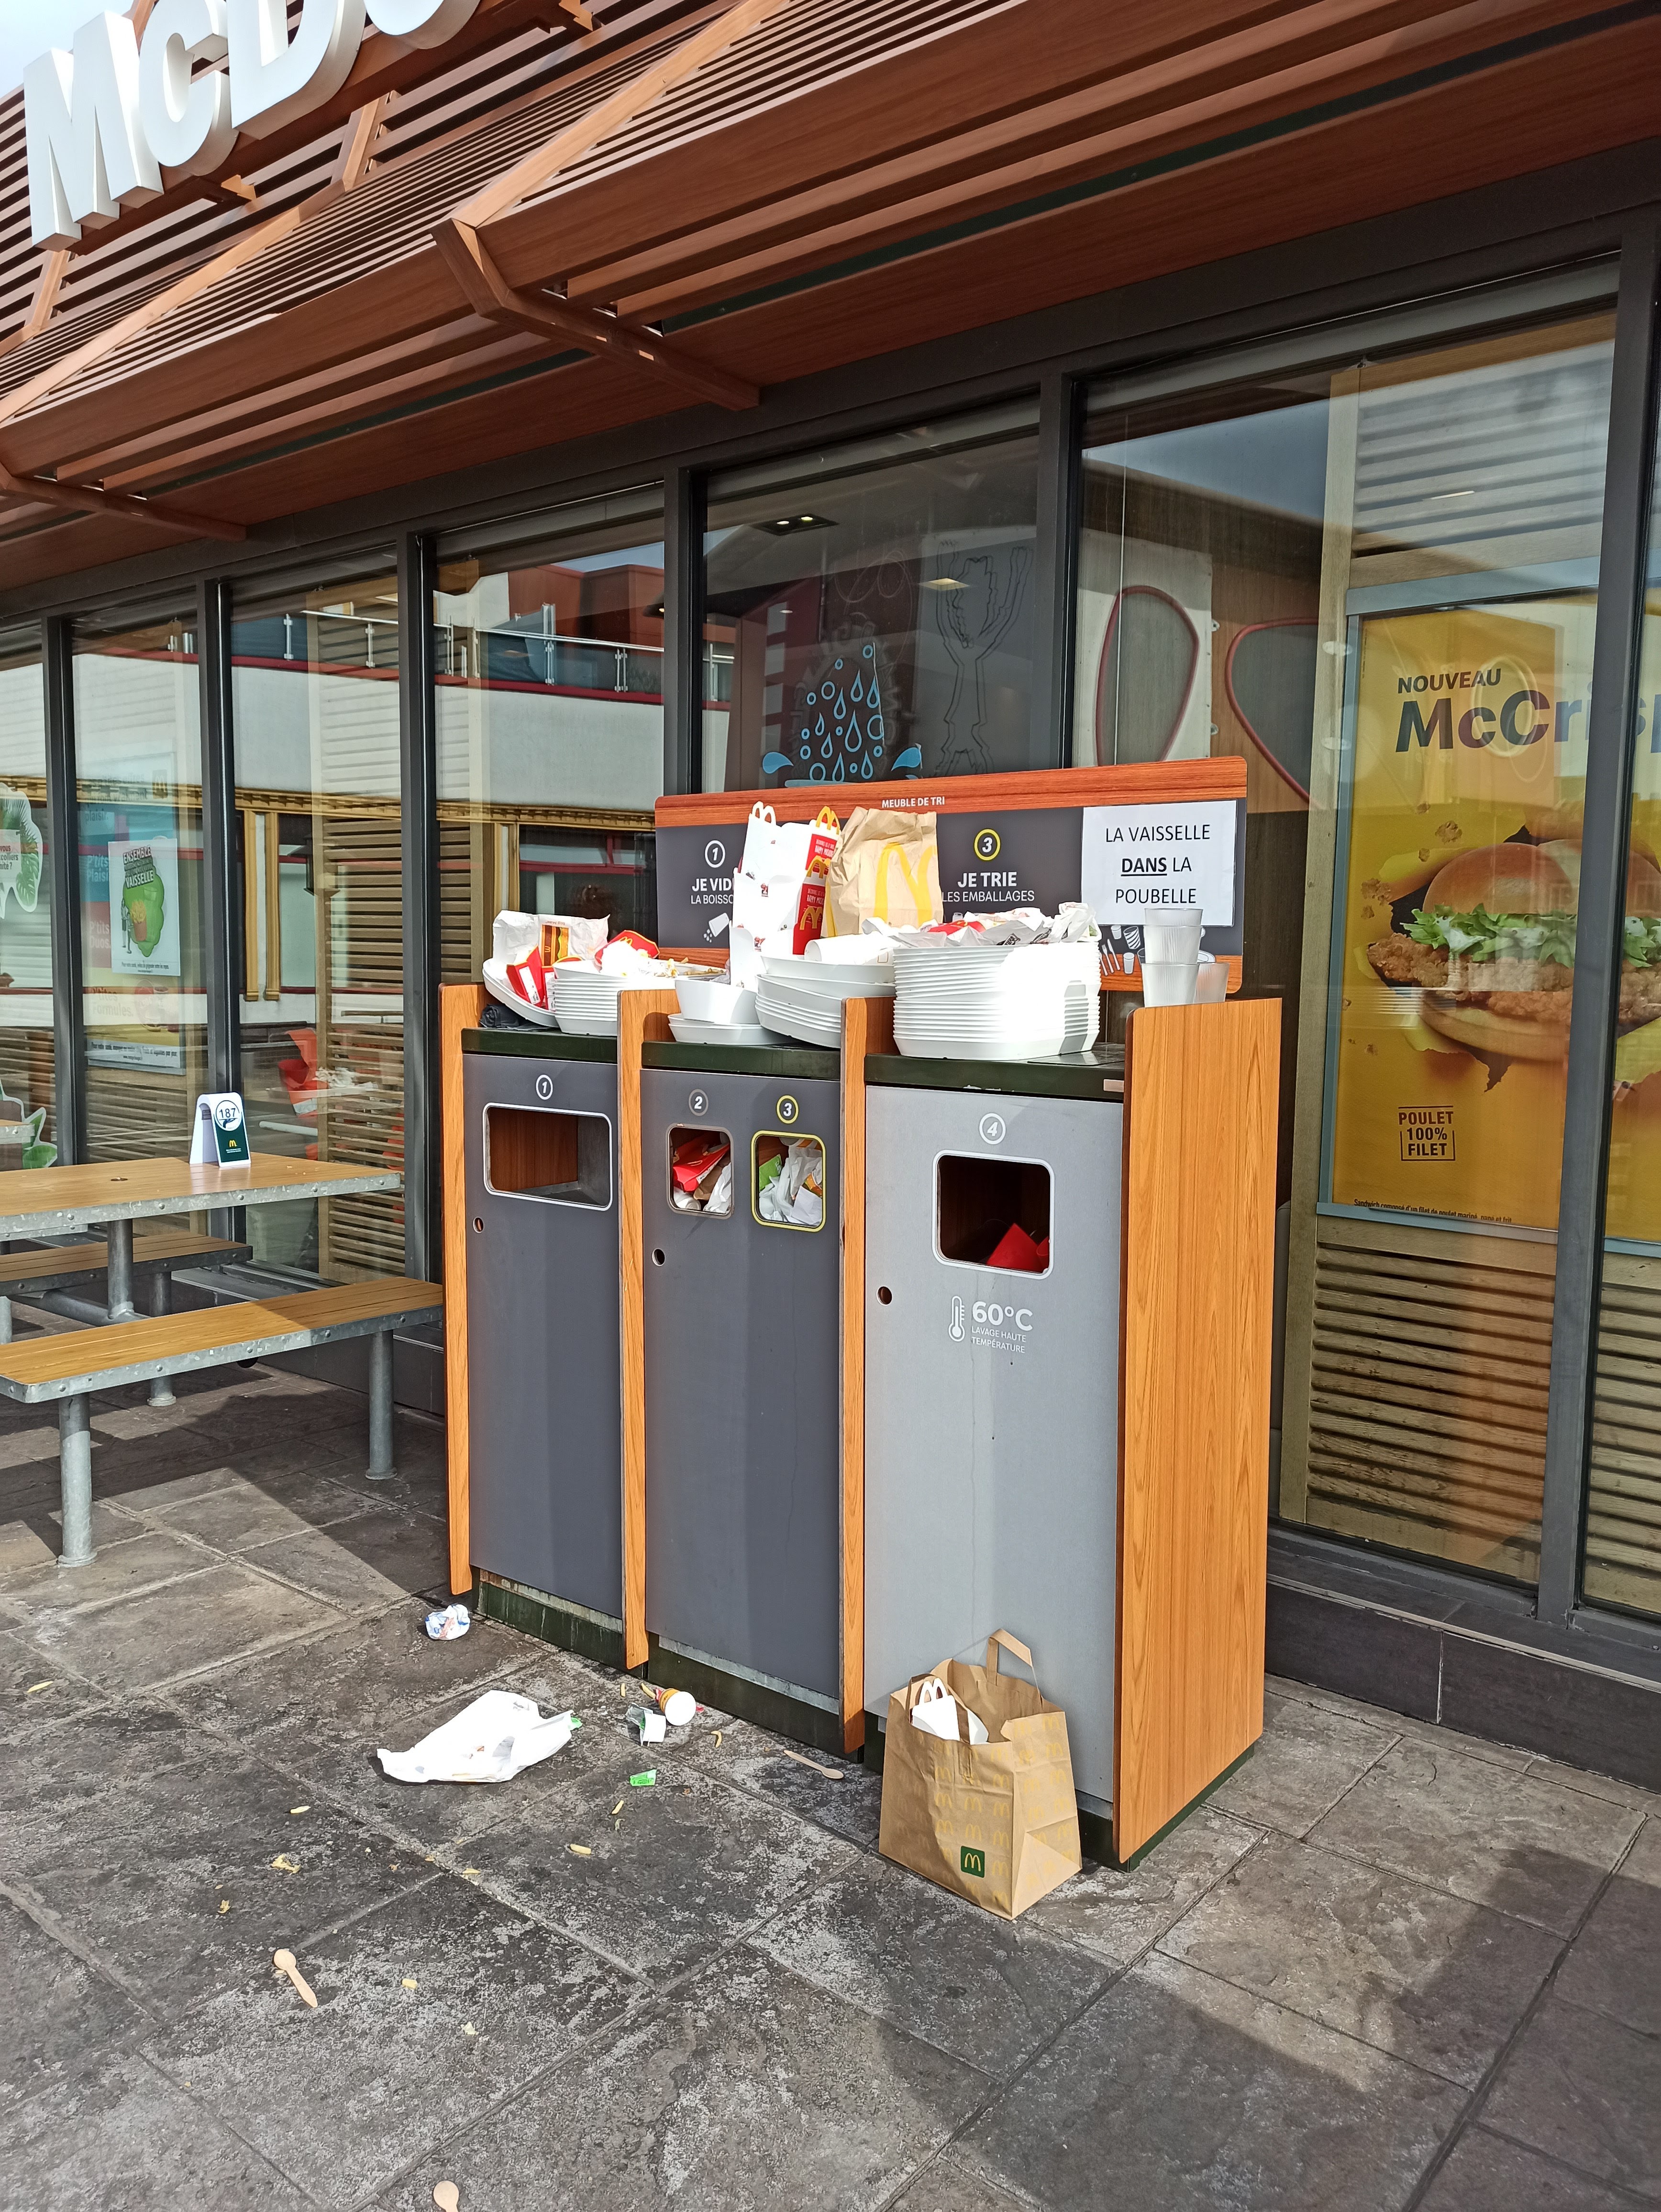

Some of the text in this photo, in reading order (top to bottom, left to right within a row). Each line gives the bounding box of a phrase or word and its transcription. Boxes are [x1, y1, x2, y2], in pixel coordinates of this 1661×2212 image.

[1397, 668, 1501, 694] NOUVEAU
[1395, 682, 1661, 753] McCr
[882, 796, 945, 808] MEUBLE DE TRI
[1105, 824, 1210, 842] LA VAISSELLE
[982, 838, 992, 852] 3
[123, 846, 152, 864] ENSEMBLE
[712, 847, 719, 861] 1
[1121, 857, 1192, 874] DANS LA
[125, 870, 154, 888] VAISSELLE
[692, 878, 734, 891] JE VID
[957, 871, 1017, 887] JE TRIE
[691, 895, 701, 904] LA
[942, 890, 1035, 902] LES EMBALLAGES
[1116, 888, 1196, 904] POUBELLE
[542, 1081, 548, 1094] 1
[219, 1108, 236, 1118] 187
[694, 1096, 793, 1117] 2 3
[1399, 1111, 1453, 1125] POULET
[987, 1122, 998, 1136] 4
[1406, 1127, 1448, 1141] 100%
[1407, 1142, 1448, 1156] FILET
[1354, 1198, 1379, 1207] Sandwich
[972, 1301, 1033, 1331] 60°C
[972, 1326, 1026, 1343] LAVAGE HAUTE
[972, 1336, 1025, 1354] TEMPÉRATURE
